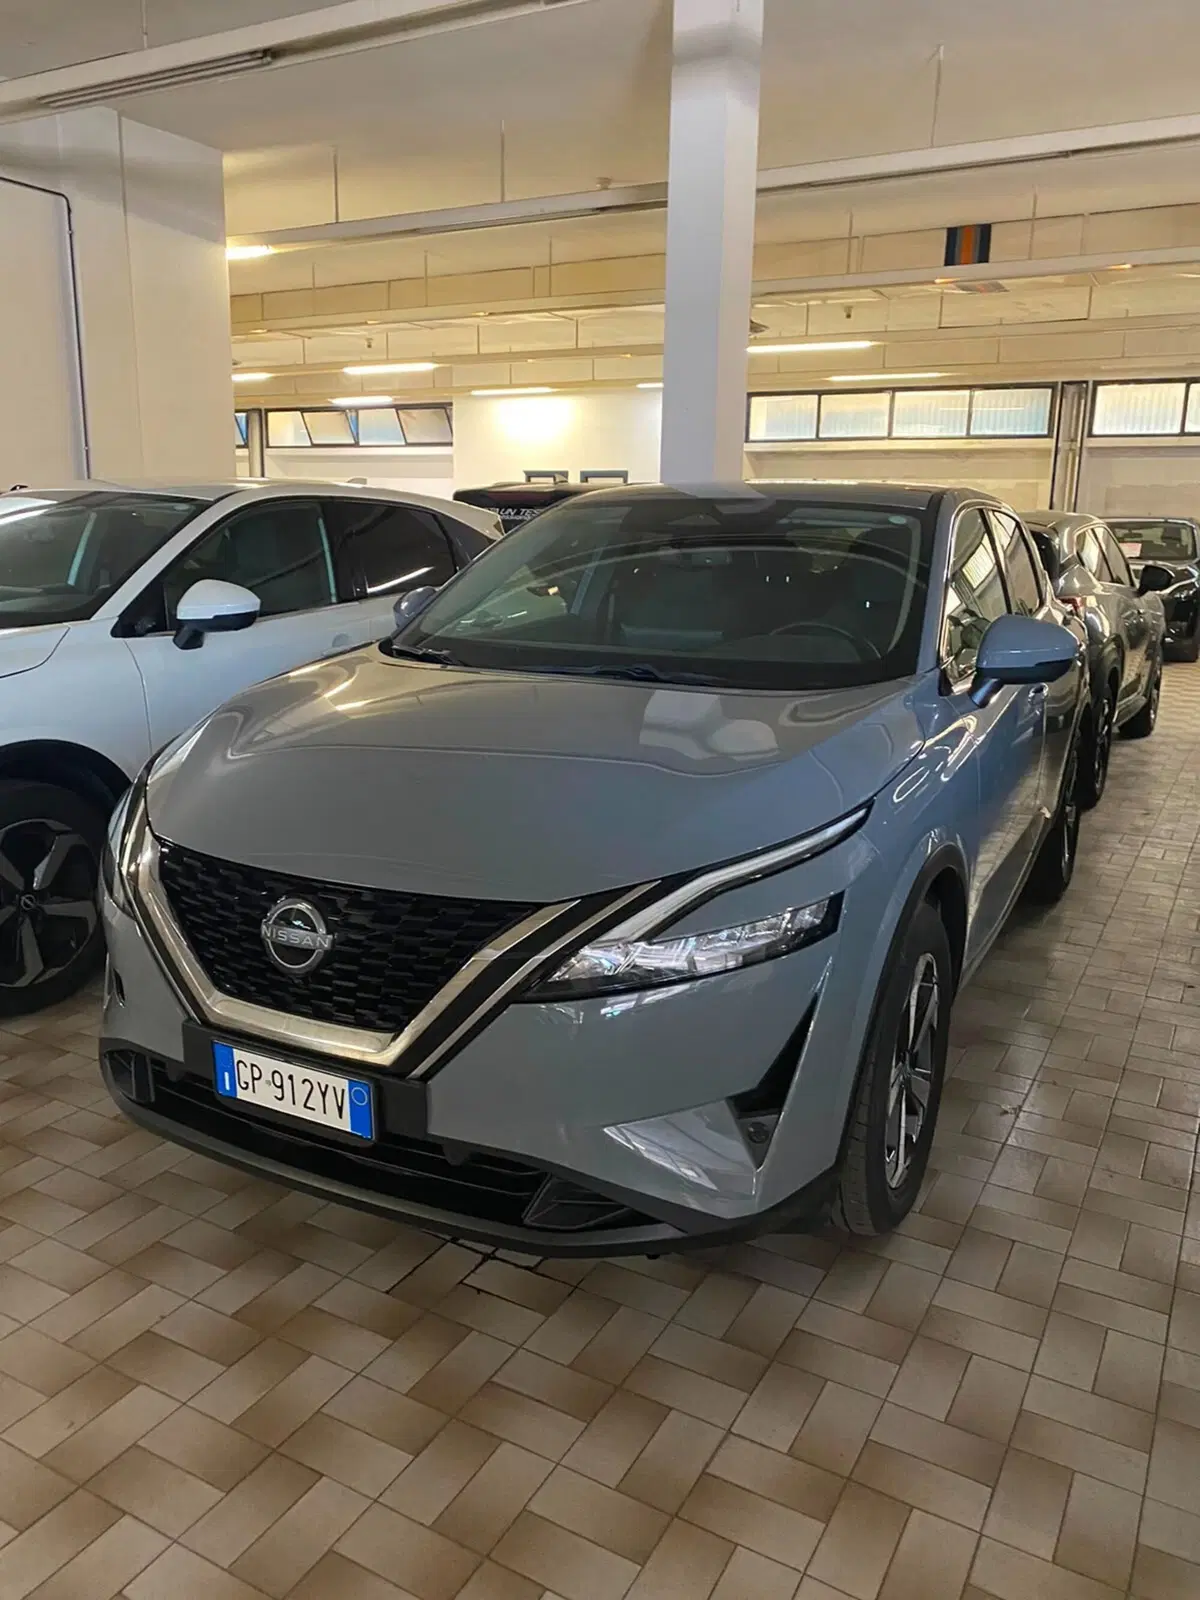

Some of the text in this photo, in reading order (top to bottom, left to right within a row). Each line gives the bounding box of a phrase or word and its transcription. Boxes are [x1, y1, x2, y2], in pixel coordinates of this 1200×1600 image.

[262, 924, 329, 948] NISSAN
[236, 1060, 262, 1094] GP
[271, 1069, 345, 1119] 912YV
